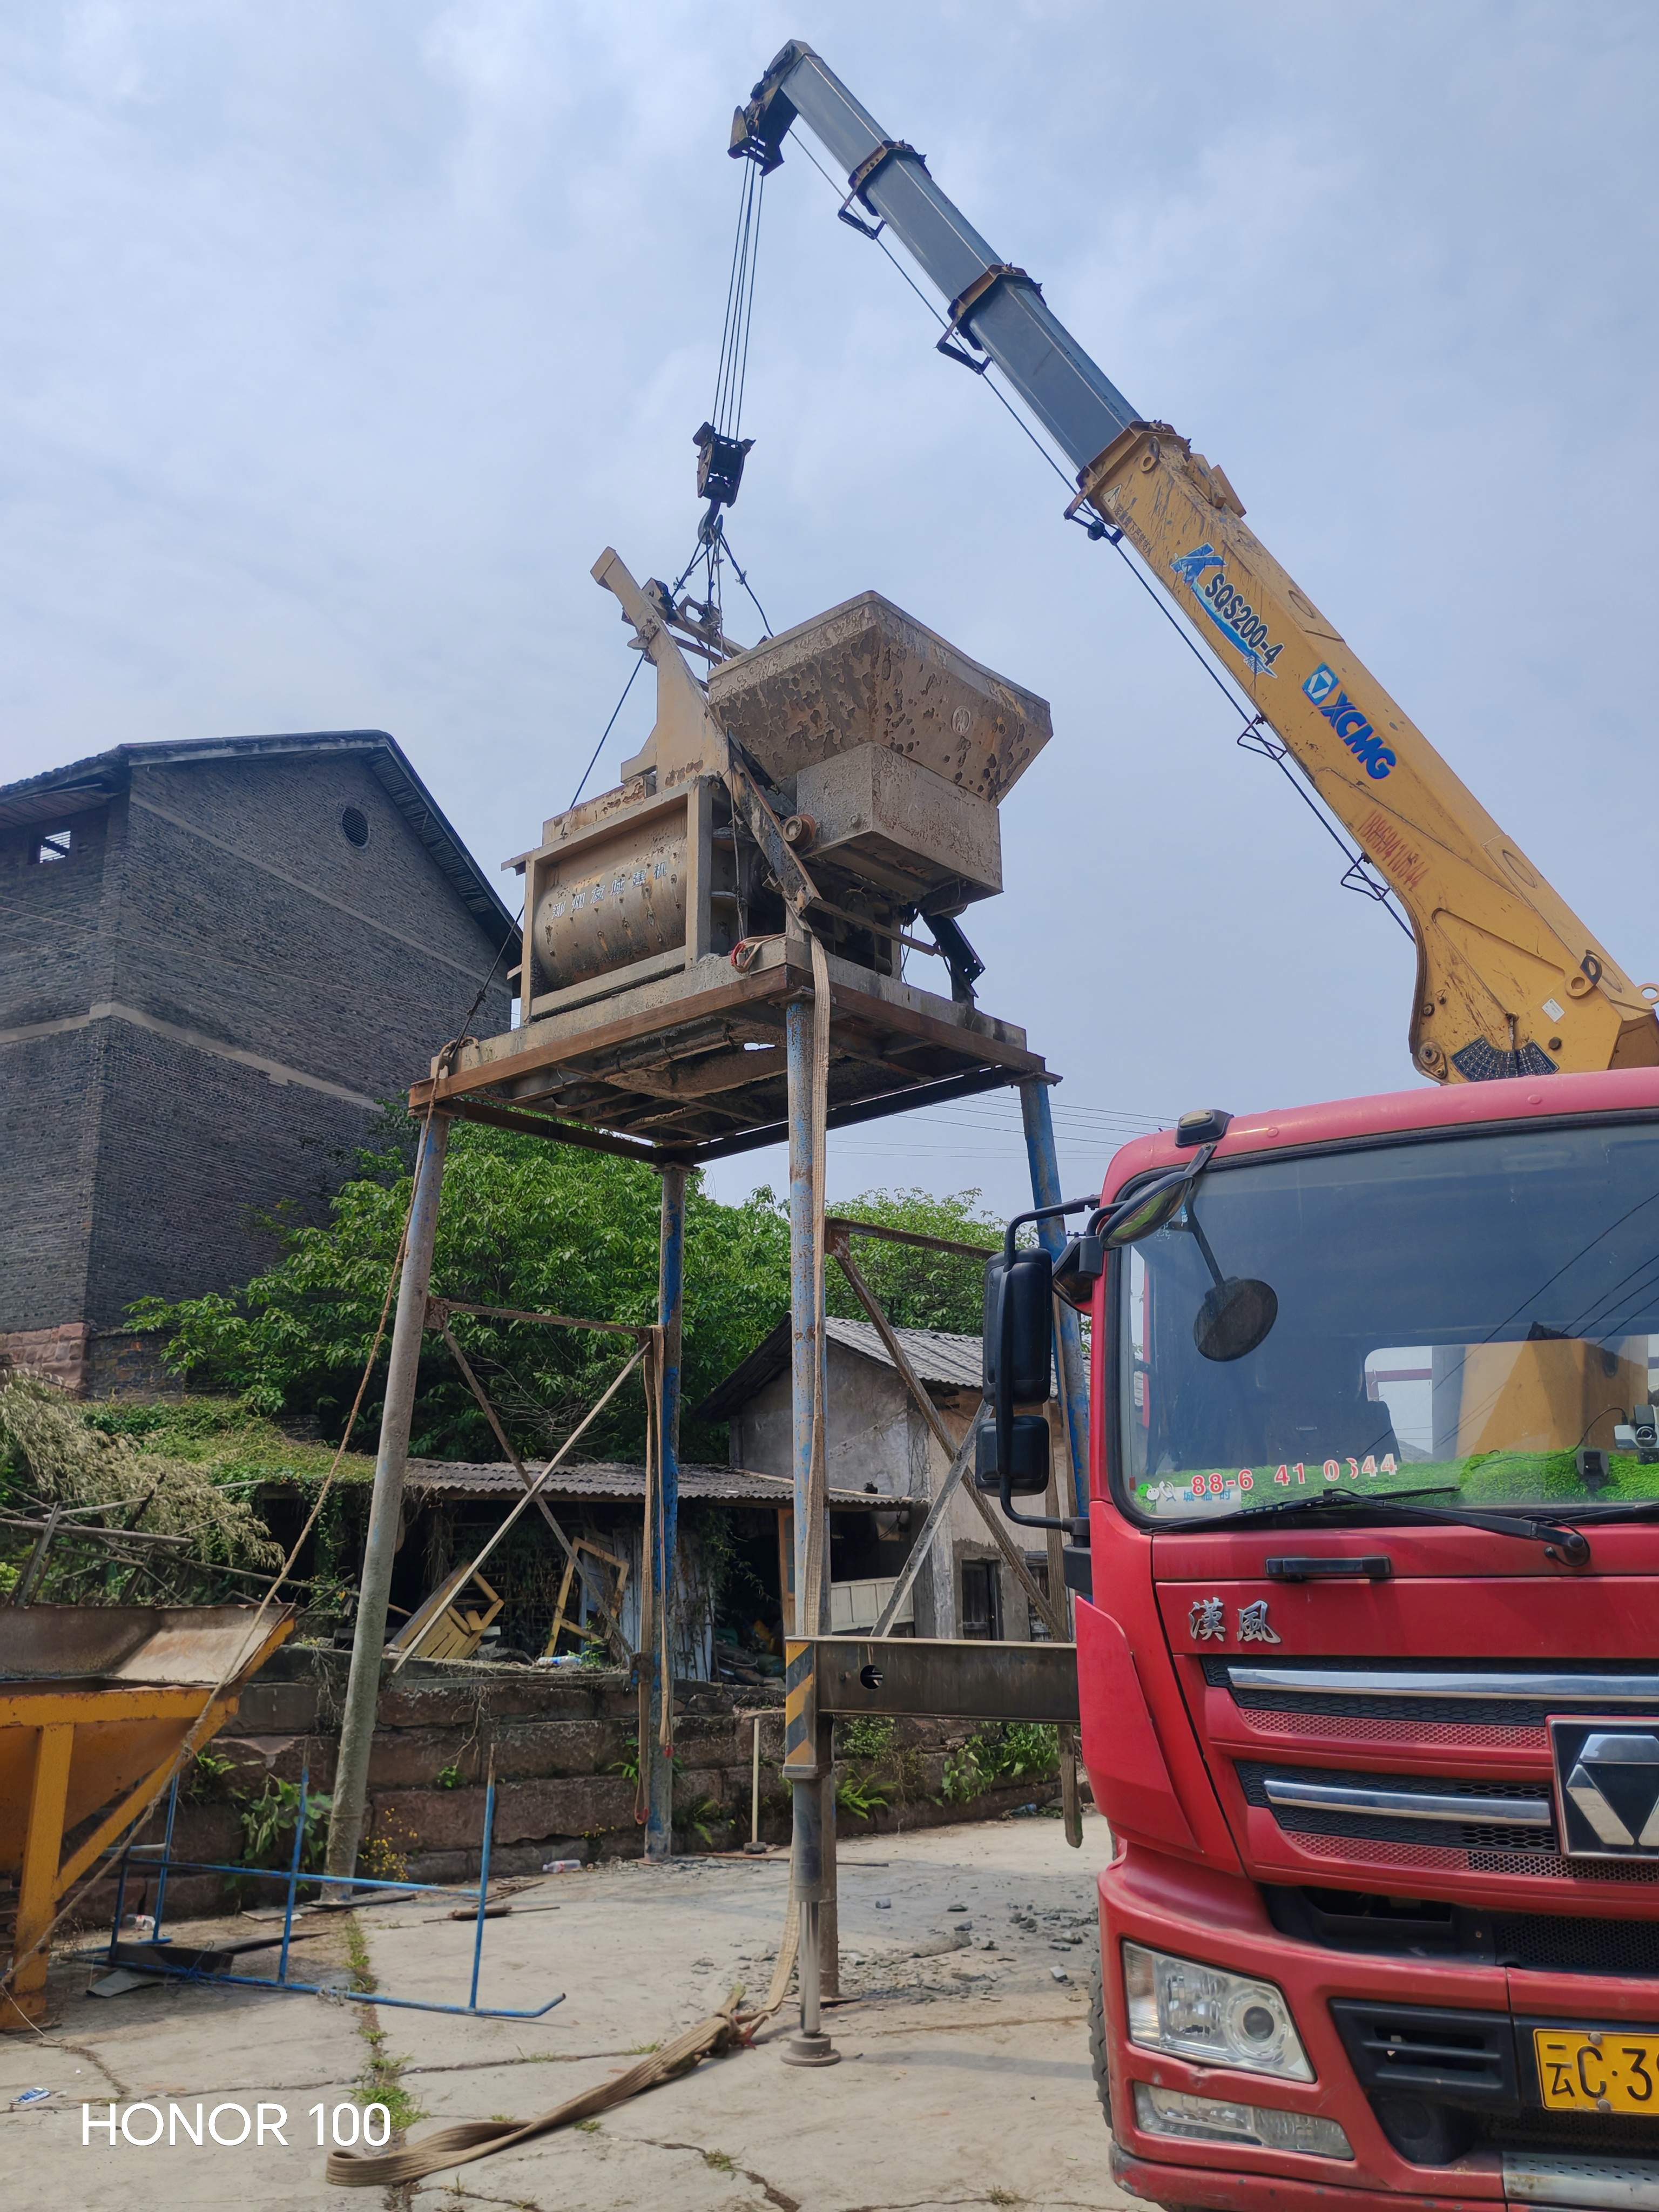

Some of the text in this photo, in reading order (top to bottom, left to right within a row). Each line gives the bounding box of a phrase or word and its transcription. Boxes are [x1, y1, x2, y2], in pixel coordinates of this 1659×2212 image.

[1205, 572, 1285, 666] SQS200-4
[1317, 690, 1397, 779] XCMG
[551, 860, 667, 920] 郑州友城建机
[1191, 1469, 1254, 1496] 88-6
[1274, 1462, 1306, 1486] 41
[1188, 1597, 1282, 1643] 漢風
[1546, 2044, 1659, 2101] 云C·3
